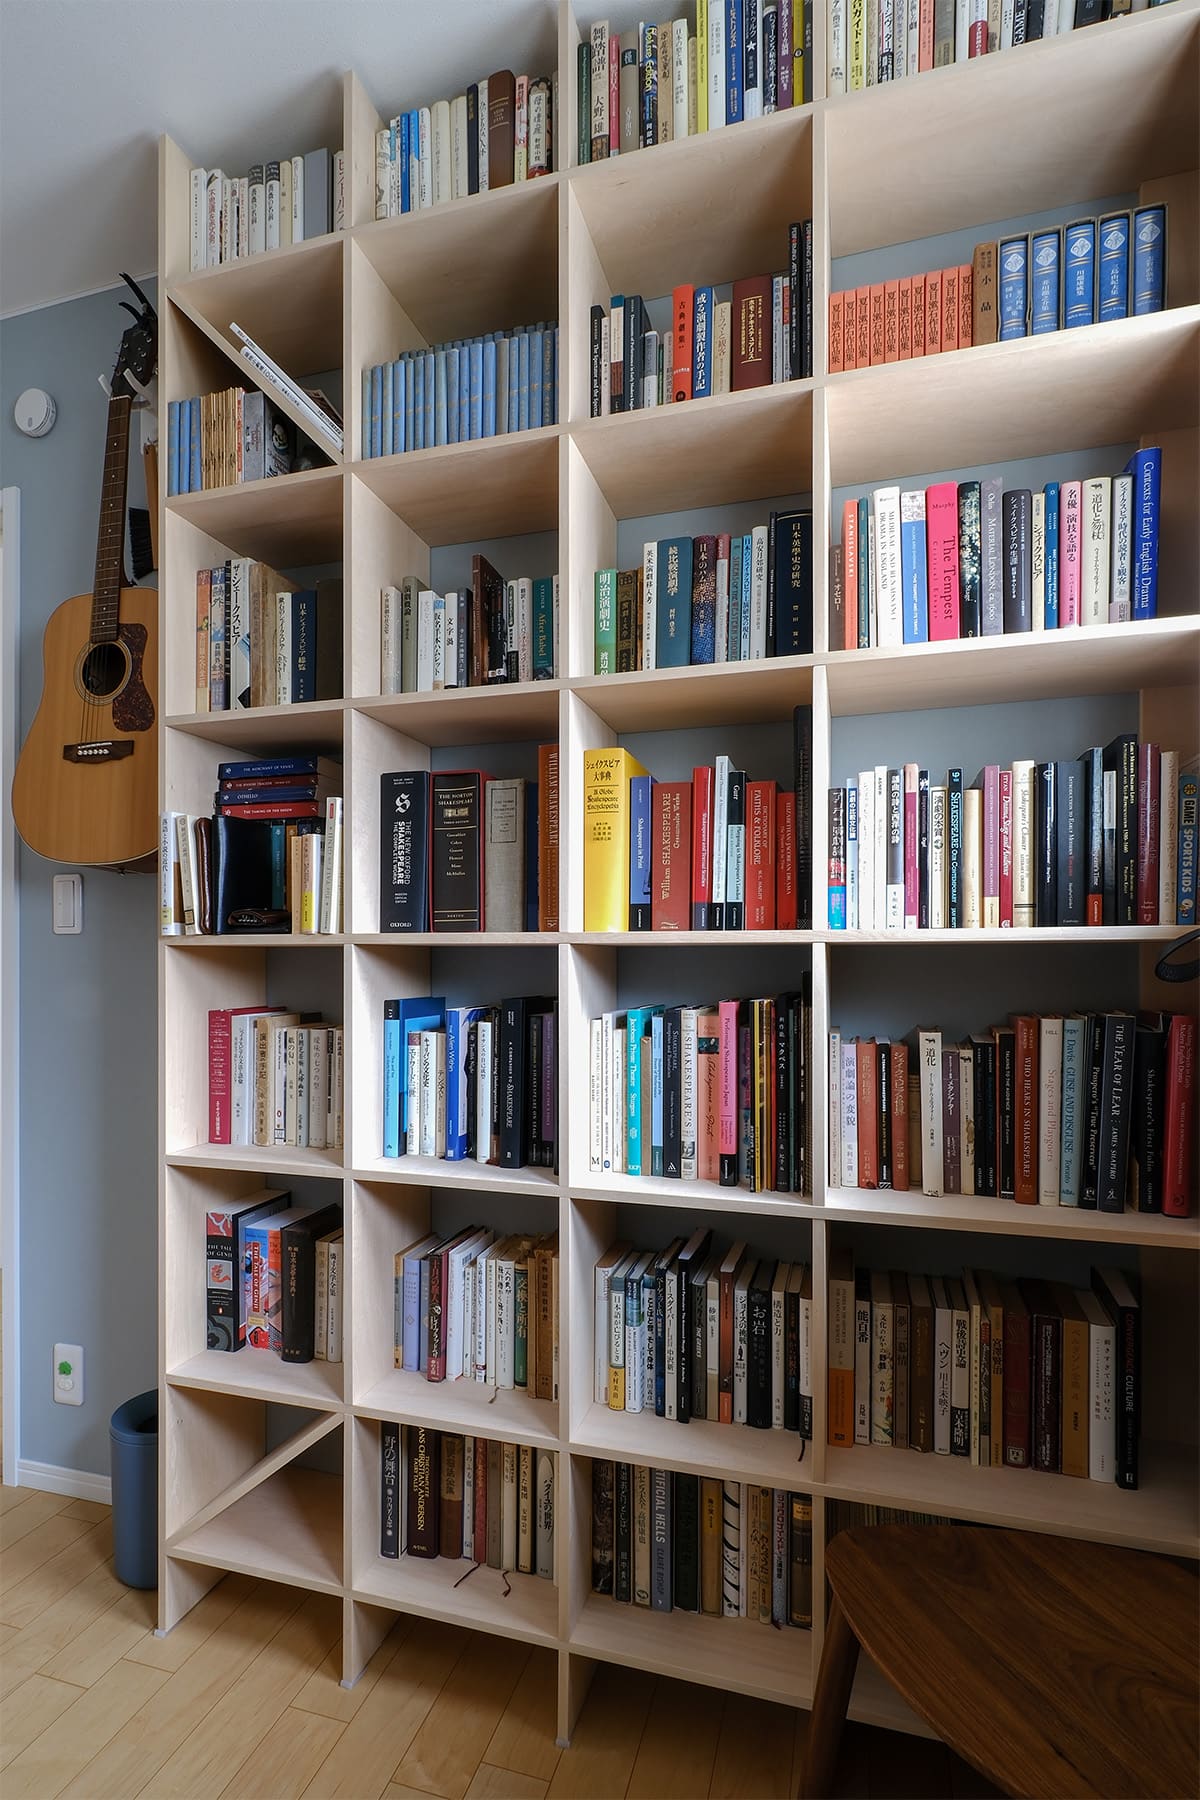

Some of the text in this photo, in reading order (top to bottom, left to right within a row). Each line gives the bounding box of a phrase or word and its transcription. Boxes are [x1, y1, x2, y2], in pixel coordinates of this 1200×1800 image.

[853, 0, 862, 39] ガイド
[1067, 489, 1077, 509] 名優
[1066, 514, 1077, 561] 演技を語る
[1140, 462, 1154, 608] Contexts for Early English Drama
[1034, 524, 1043, 580] シェイクスピア
[940, 536, 956, 619] The Tempest
[232, 564, 241, 645] ザ・シェークスピア
[600, 573, 609, 631] 明治演劇史
[539, 613, 547, 633] After
[539, 635, 547, 656] Babel
[586, 759, 620, 769] シェイクスピア
[594, 772, 611, 781] 大事典
[549, 752, 558, 845] WILLIAM SHAKESPEARE
[1184, 800, 1196, 823] GAME
[951, 792, 961, 848] SHAKESPEARE
[397, 821, 405, 884] SHAKESPEARE
[663, 793, 671, 899] William SHAKESPEARE
[1182, 829, 1193, 893] SPORTS KIDS
[926, 1048, 937, 1066] 道化
[1114, 1045, 1125, 1070] YEAR
[1114, 1074, 1122, 1085] OF
[1024, 1108, 1031, 1117] IN
[1045, 1070, 1056, 1162] Stages and Playgoers
[1064, 1039, 1075, 1183] Davis GUISE AND DISGUISE Toronto
[1112, 1088, 1122, 1115] LEAR
[753, 1306, 767, 1335] お岩
[857, 1310, 869, 1343] 能百番
[939, 1342, 949, 1369] ヘヴン
[656, 1514, 665, 1543] HELLS
